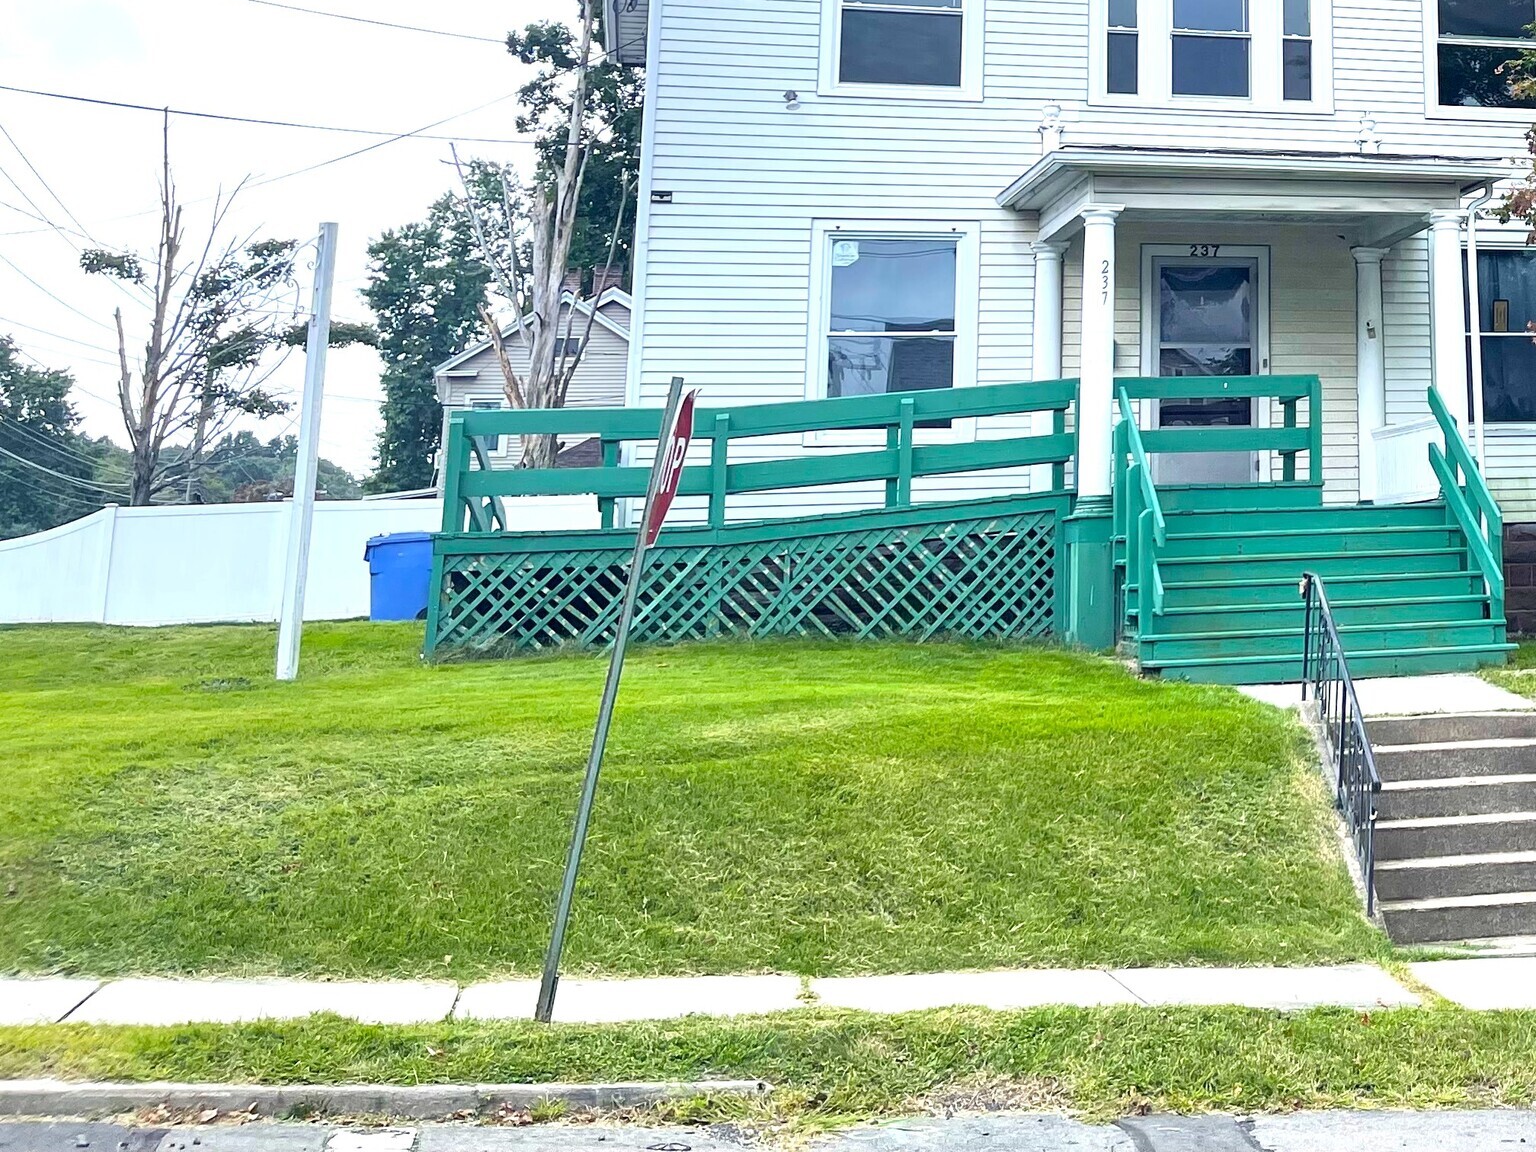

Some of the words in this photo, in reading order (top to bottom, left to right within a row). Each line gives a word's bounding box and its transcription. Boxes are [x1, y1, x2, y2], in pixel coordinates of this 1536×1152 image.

[1190, 244, 1220, 257] 237
[1101, 259, 1109, 306] 237
[660, 435, 686, 495] OP
